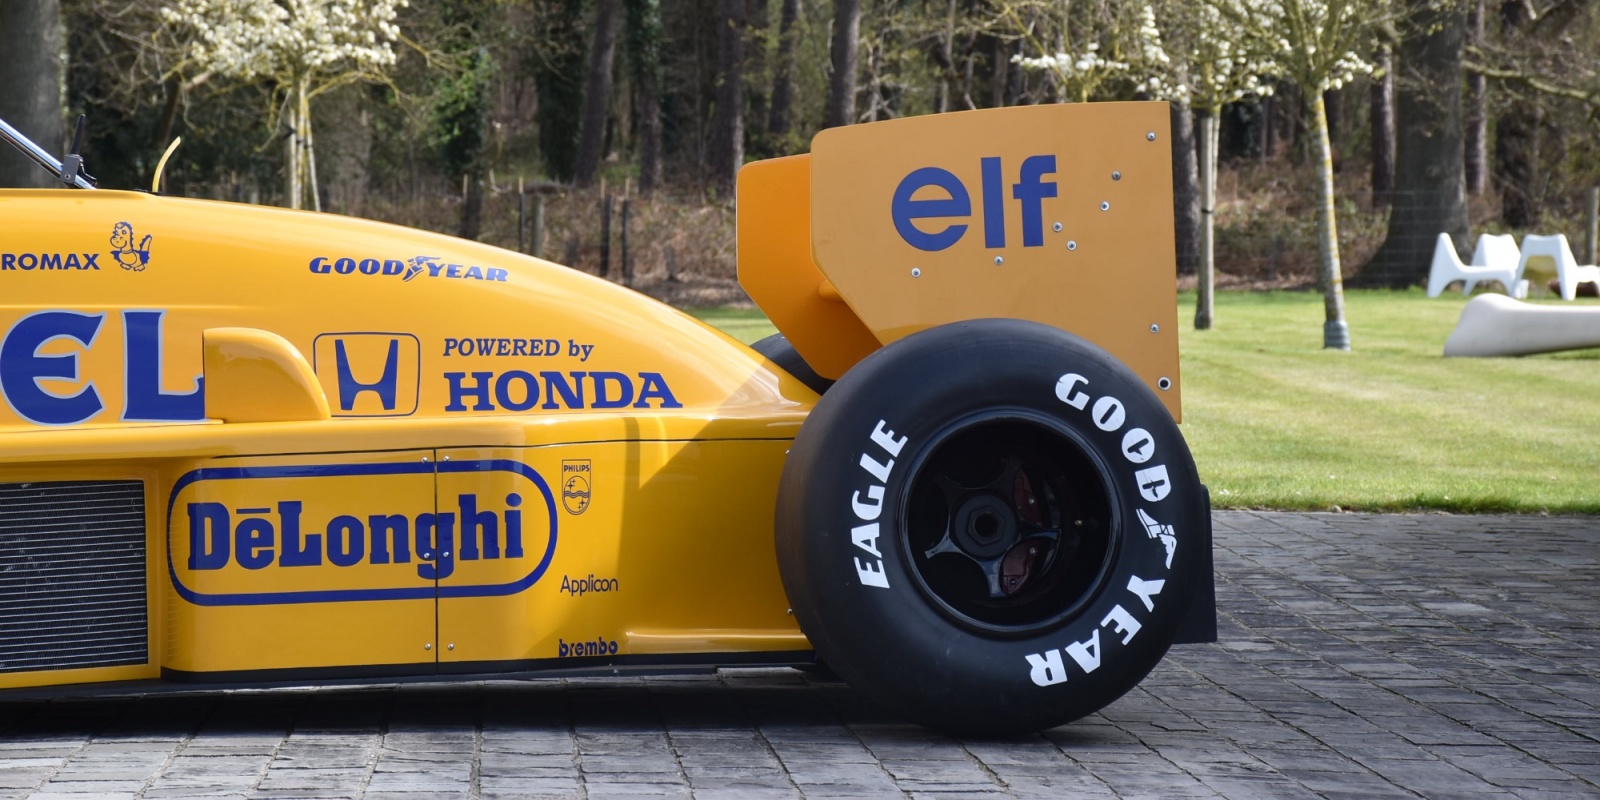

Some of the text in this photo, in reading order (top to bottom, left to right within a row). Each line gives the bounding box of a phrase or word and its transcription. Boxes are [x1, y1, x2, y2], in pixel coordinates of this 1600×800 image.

[892, 155, 1058, 252] elf
[1, 253, 101, 271] ROMAX
[443, 338, 595, 362] POWERED by
[0, 309, 206, 426] EL
[443, 370, 684, 412] HONDA
[563, 464, 590, 473] PHILIPS
[851, 419, 908, 589] EAGLE
[559, 574, 619, 597] Applicon
[559, 637, 619, 658] brembo
